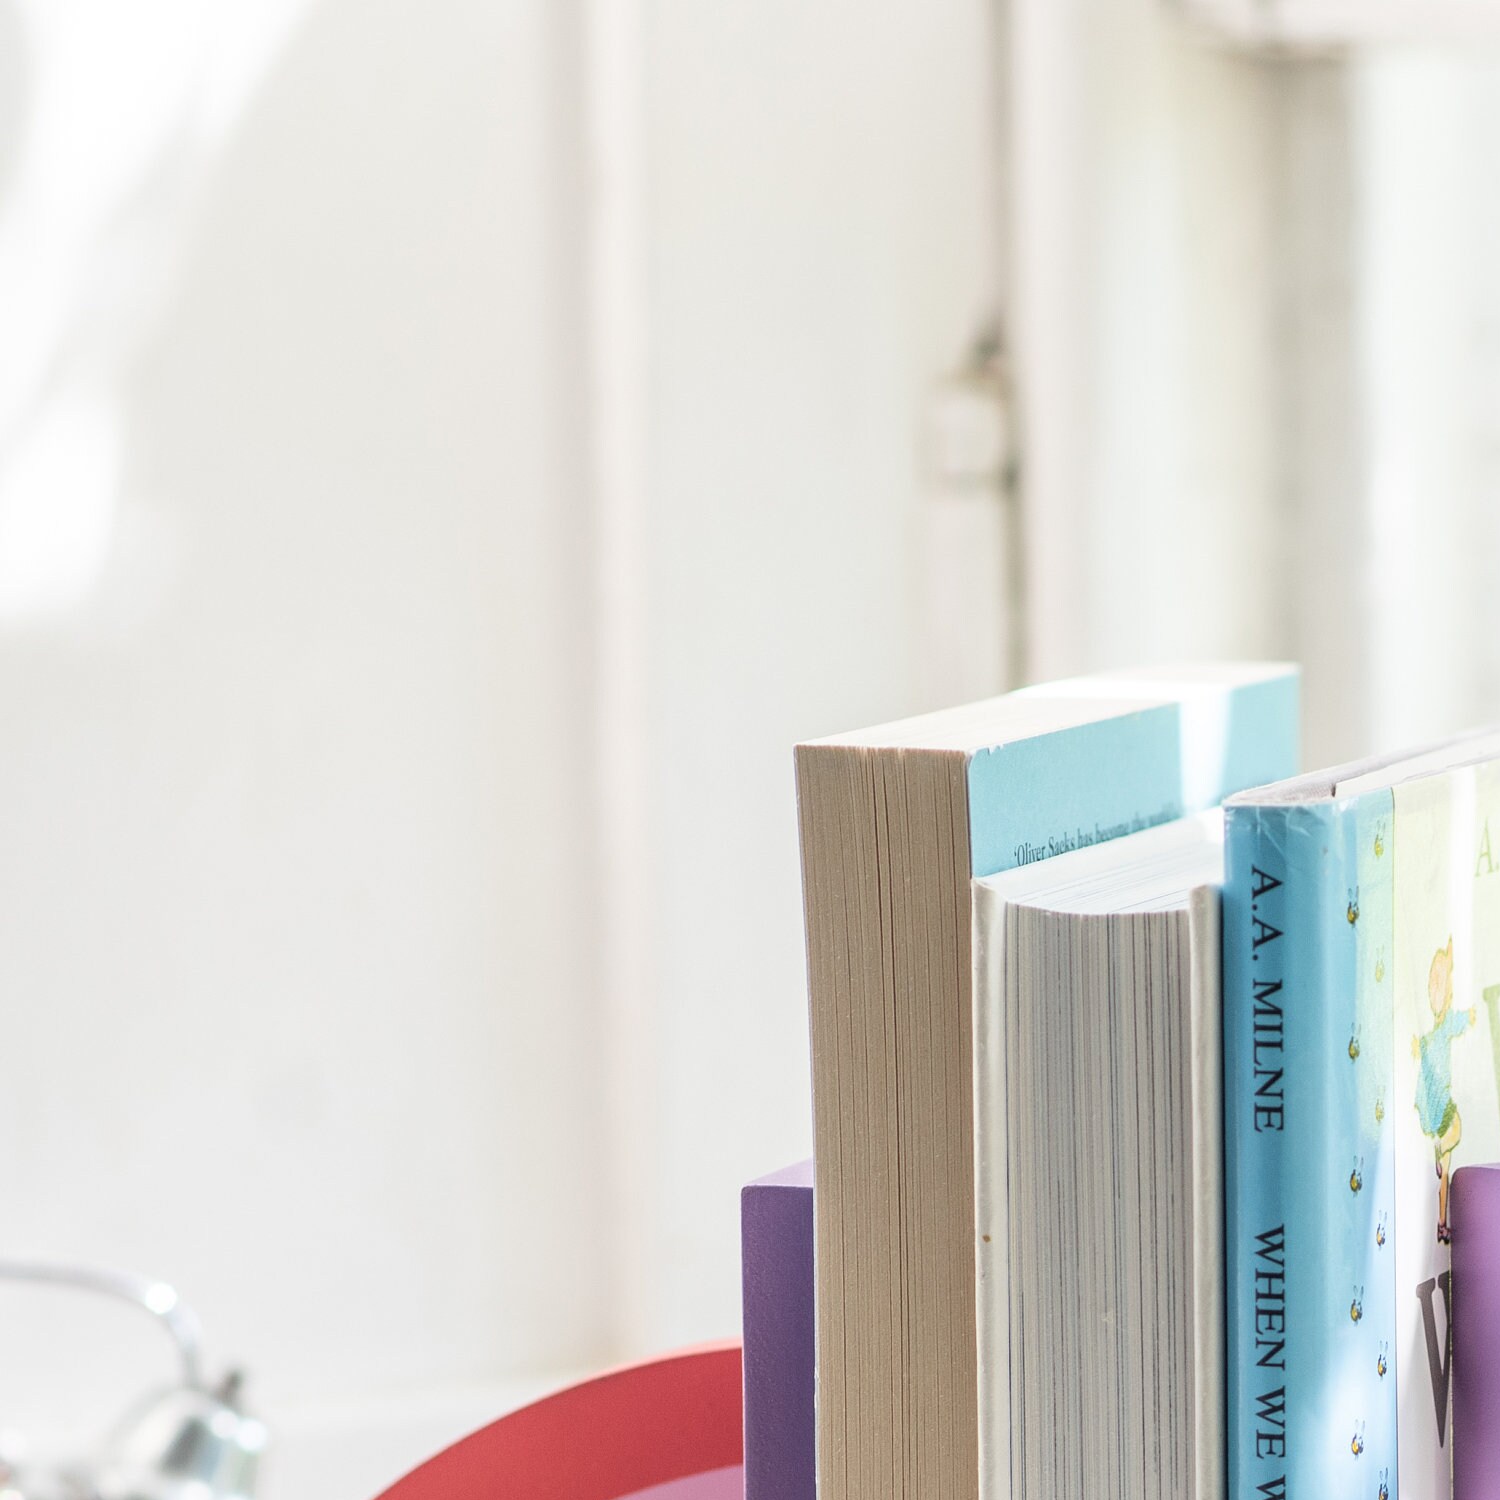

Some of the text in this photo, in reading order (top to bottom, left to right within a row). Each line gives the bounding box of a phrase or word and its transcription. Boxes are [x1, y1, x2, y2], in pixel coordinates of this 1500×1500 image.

[1048, 831, 1076, 858] Sacks
[1077, 827, 1094, 850] has
[1251, 865, 1285, 1133] A.A. MILNE
[1254, 1223, 1286, 1371] WHEN
[1255, 1385, 1286, 1460] WE
